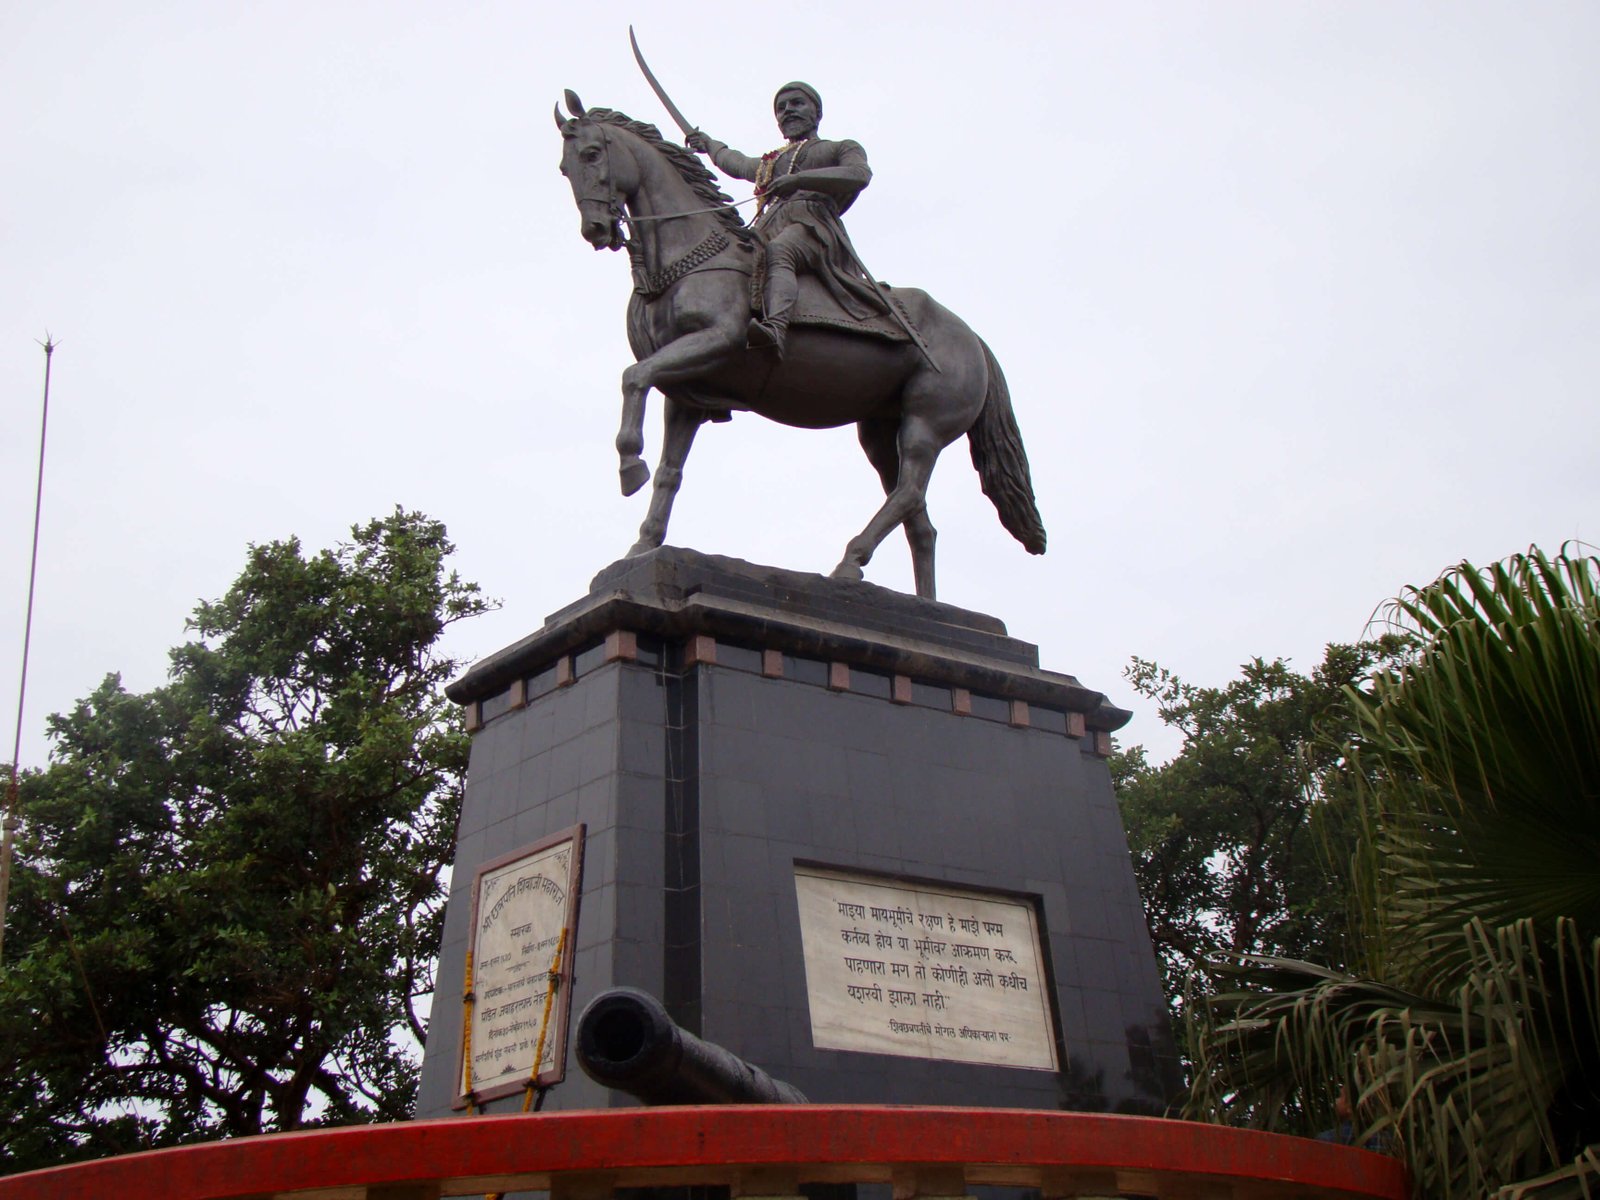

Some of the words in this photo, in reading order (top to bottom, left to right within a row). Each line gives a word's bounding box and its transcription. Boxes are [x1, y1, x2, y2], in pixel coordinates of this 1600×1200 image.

[517, 872, 542, 895] शिवाजी
[541, 877, 565, 907] महाराज
[509, 922, 533, 939] स्मारक
[918, 913, 943, 931] रक्षण
[947, 912, 956, 933] हे
[958, 915, 980, 937] माझे
[982, 921, 1004, 937] परम
[840, 926, 870, 946] कर्तव्य
[874, 929, 893, 950] होय
[897, 936, 909, 951] या
[913, 936, 947, 961] भूमीवर
[951, 943, 990, 961] आक्रमण
[843, 956, 886, 976] पाहणारा
[889, 962, 909, 979] मग
[914, 960, 926, 980] तो
[930, 963, 969, 988] कोणीही
[972, 968, 995, 989] असो
[997, 971, 1028, 991] कधीच
[847, 983, 883, 1005] यशस्वी
[887, 989, 917, 1009] झाला
